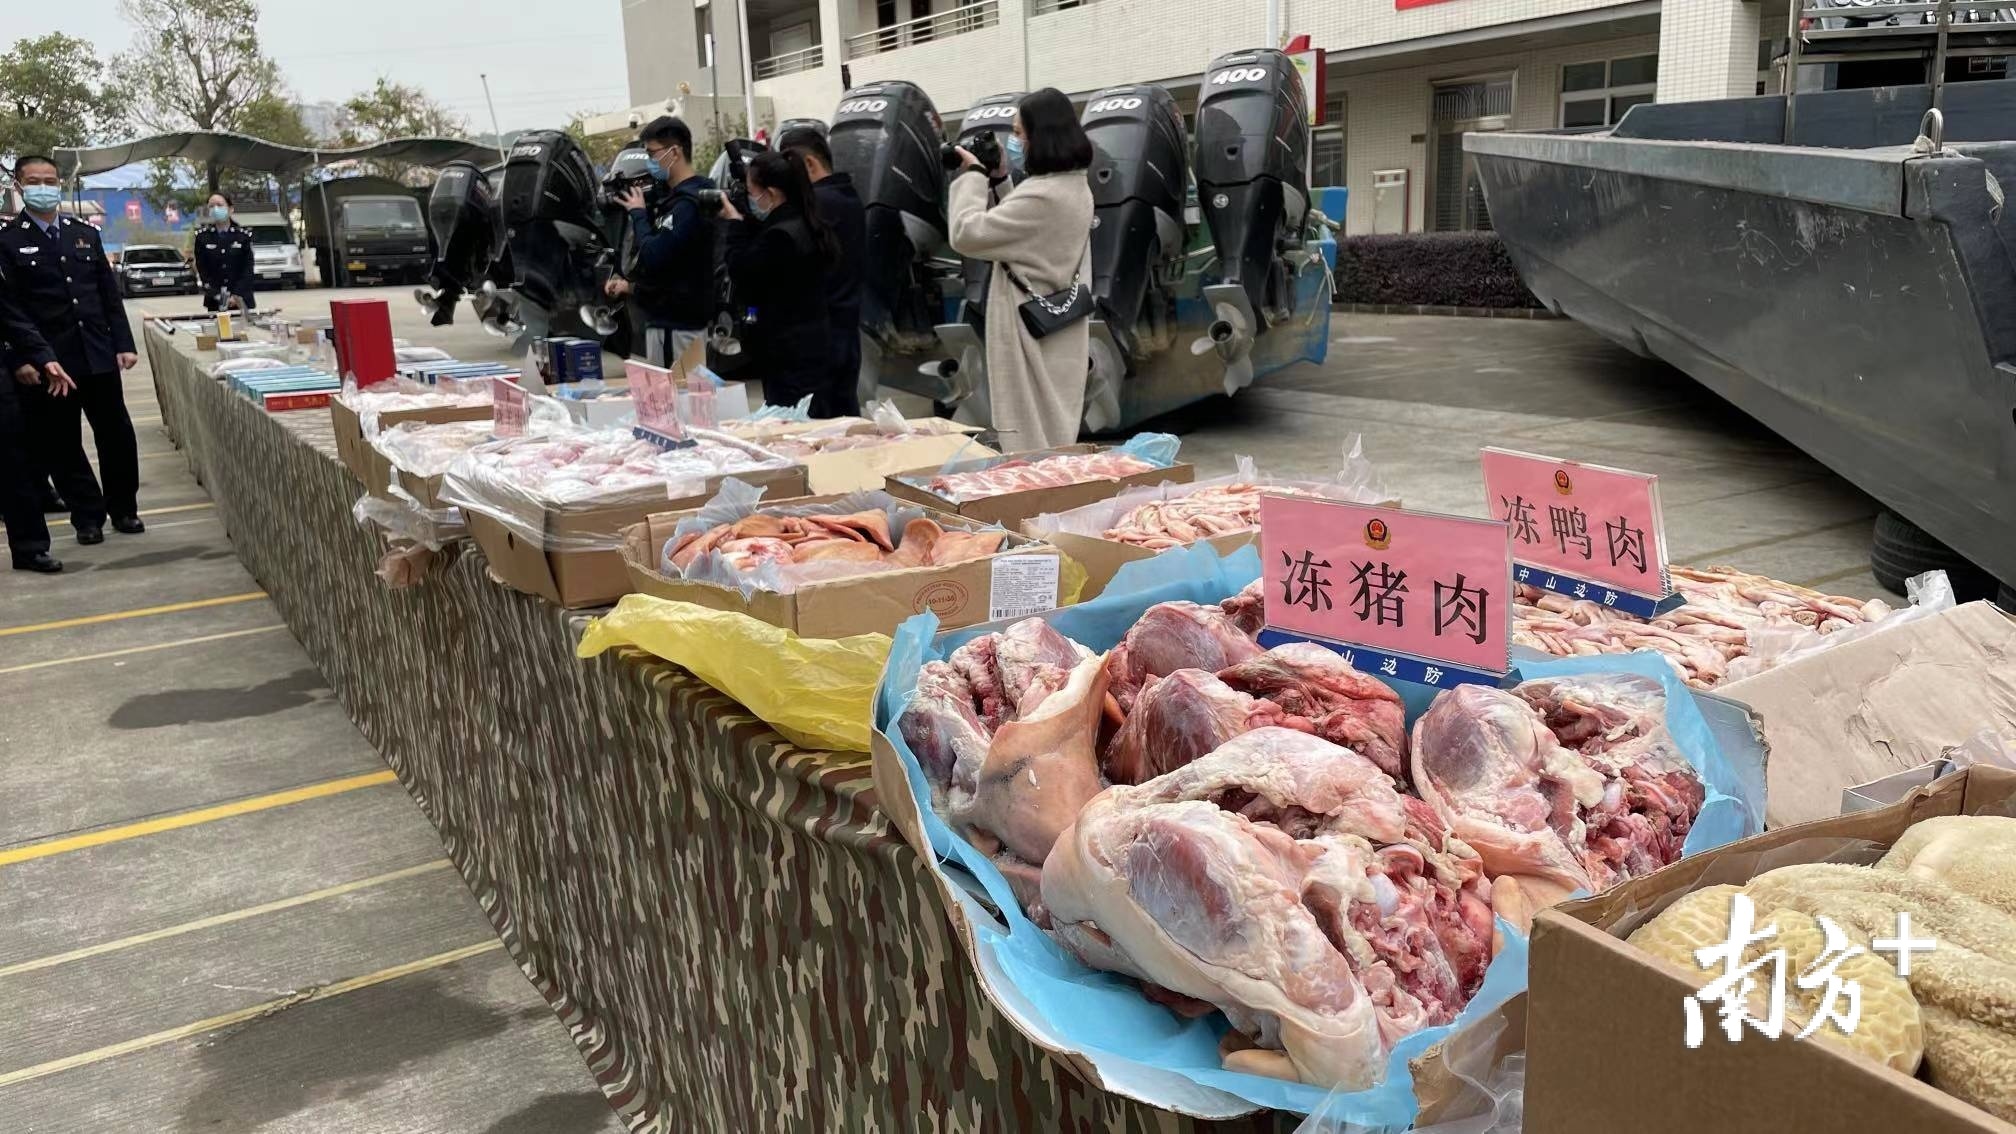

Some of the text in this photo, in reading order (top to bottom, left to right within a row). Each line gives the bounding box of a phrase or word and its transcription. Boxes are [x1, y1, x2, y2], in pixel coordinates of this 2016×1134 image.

[1211, 67, 1267, 85] 400
[839, 100, 888, 114] 400
[967, 106, 1018, 121] 400
[1090, 98, 1143, 113] 400
[1501, 495, 1648, 575] 冻鸭肉
[1280, 549, 1490, 645] 冻猪肉
[1519, 567, 1619, 606] 中山边防
[1309, 641, 1443, 684] 山边防
